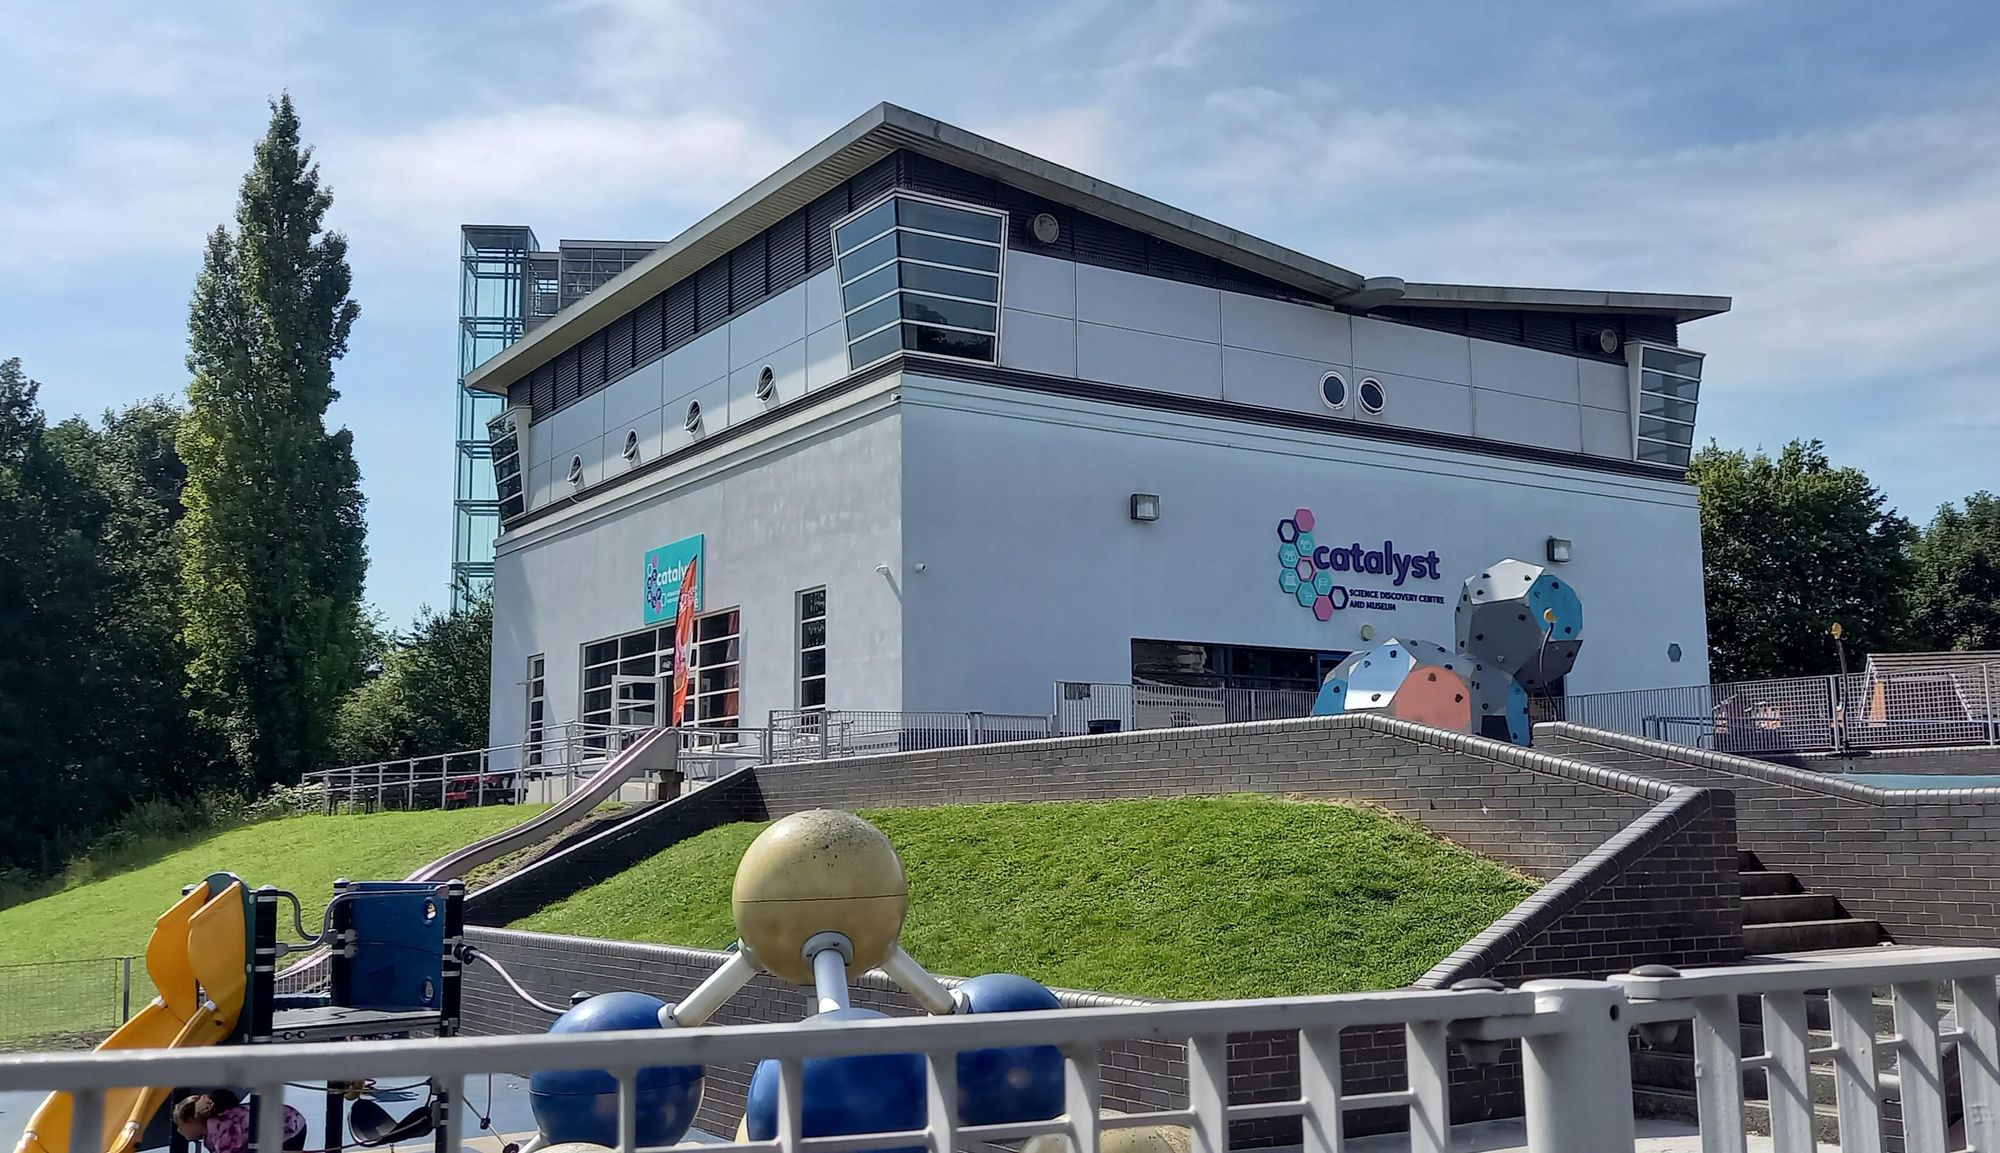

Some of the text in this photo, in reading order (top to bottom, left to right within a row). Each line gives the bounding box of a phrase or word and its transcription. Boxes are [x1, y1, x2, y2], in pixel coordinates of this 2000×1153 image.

[656, 560, 689, 587] cataly
[1312, 540, 1441, 587] catalyst
[1349, 588, 1445, 604] SCIENCE DISCOVERY CENTRE
[1349, 600, 1396, 611] AND MUSEUM
